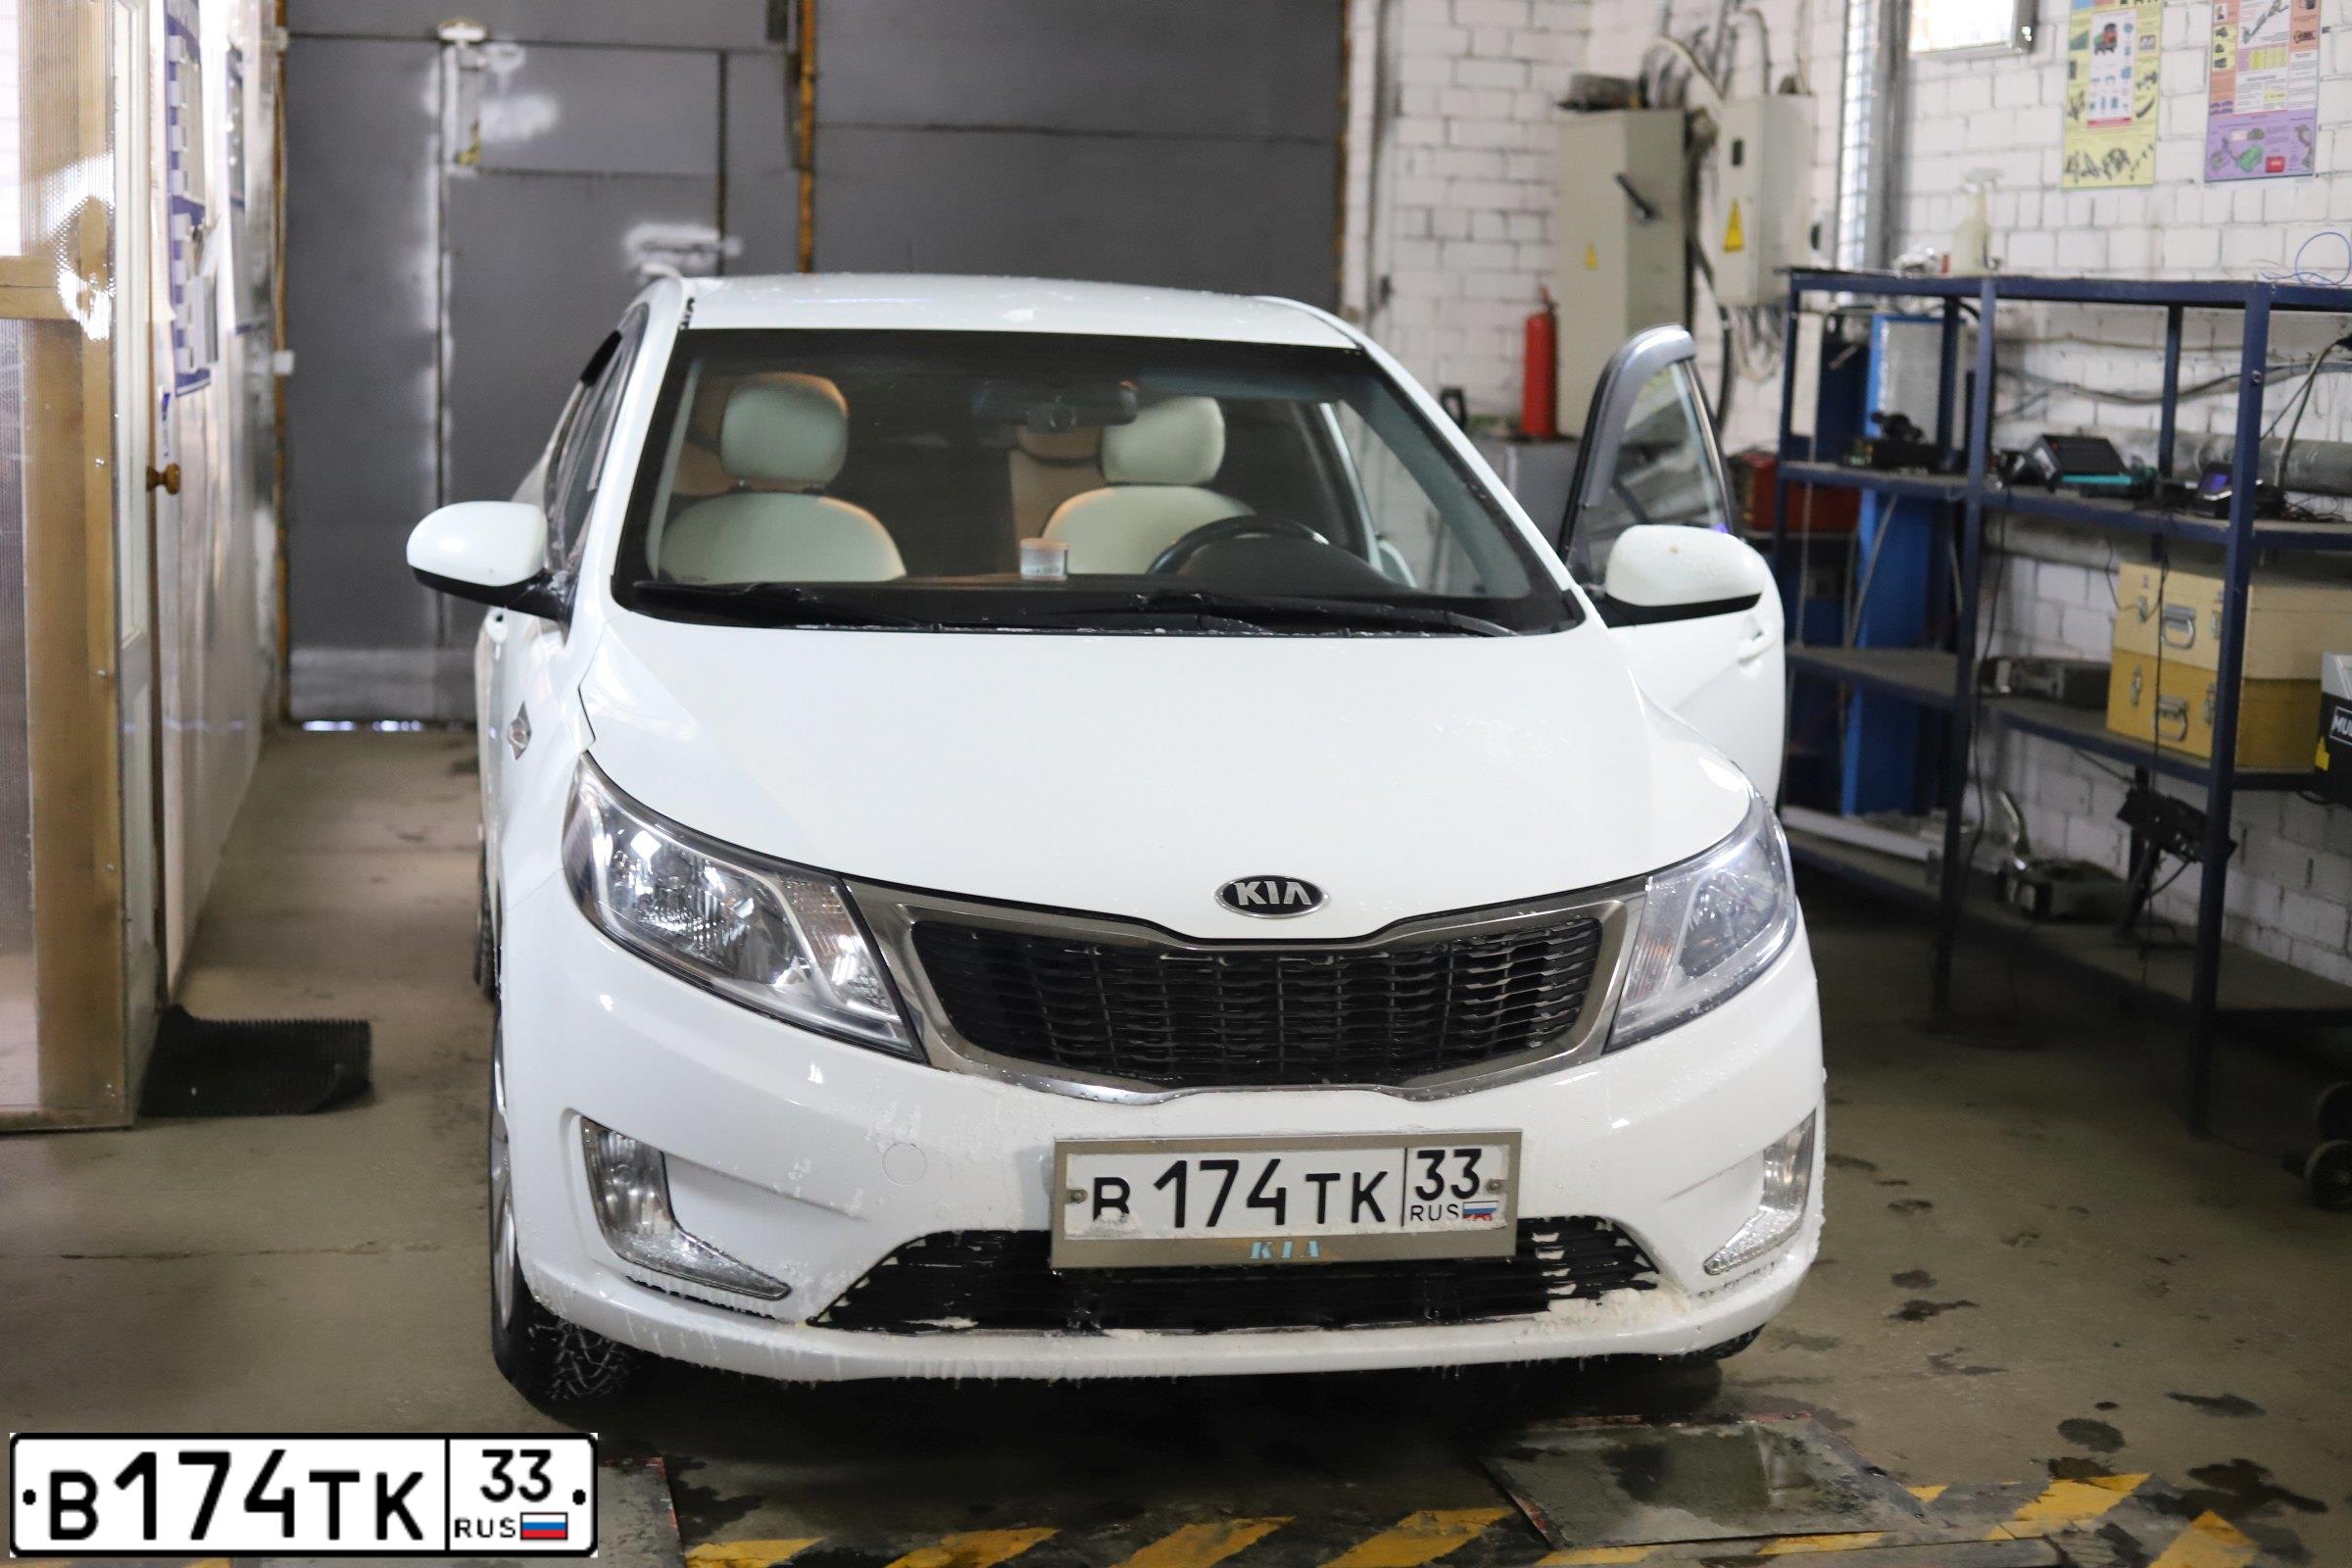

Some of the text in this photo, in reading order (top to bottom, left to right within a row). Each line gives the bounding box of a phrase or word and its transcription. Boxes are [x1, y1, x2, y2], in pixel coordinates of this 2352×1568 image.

[1235, 881, 1312, 906] KIA
[1415, 1149, 1482, 1200] 33
[1411, 1203, 1458, 1221] RUS
[1250, 1240, 1319, 1259] KIA
